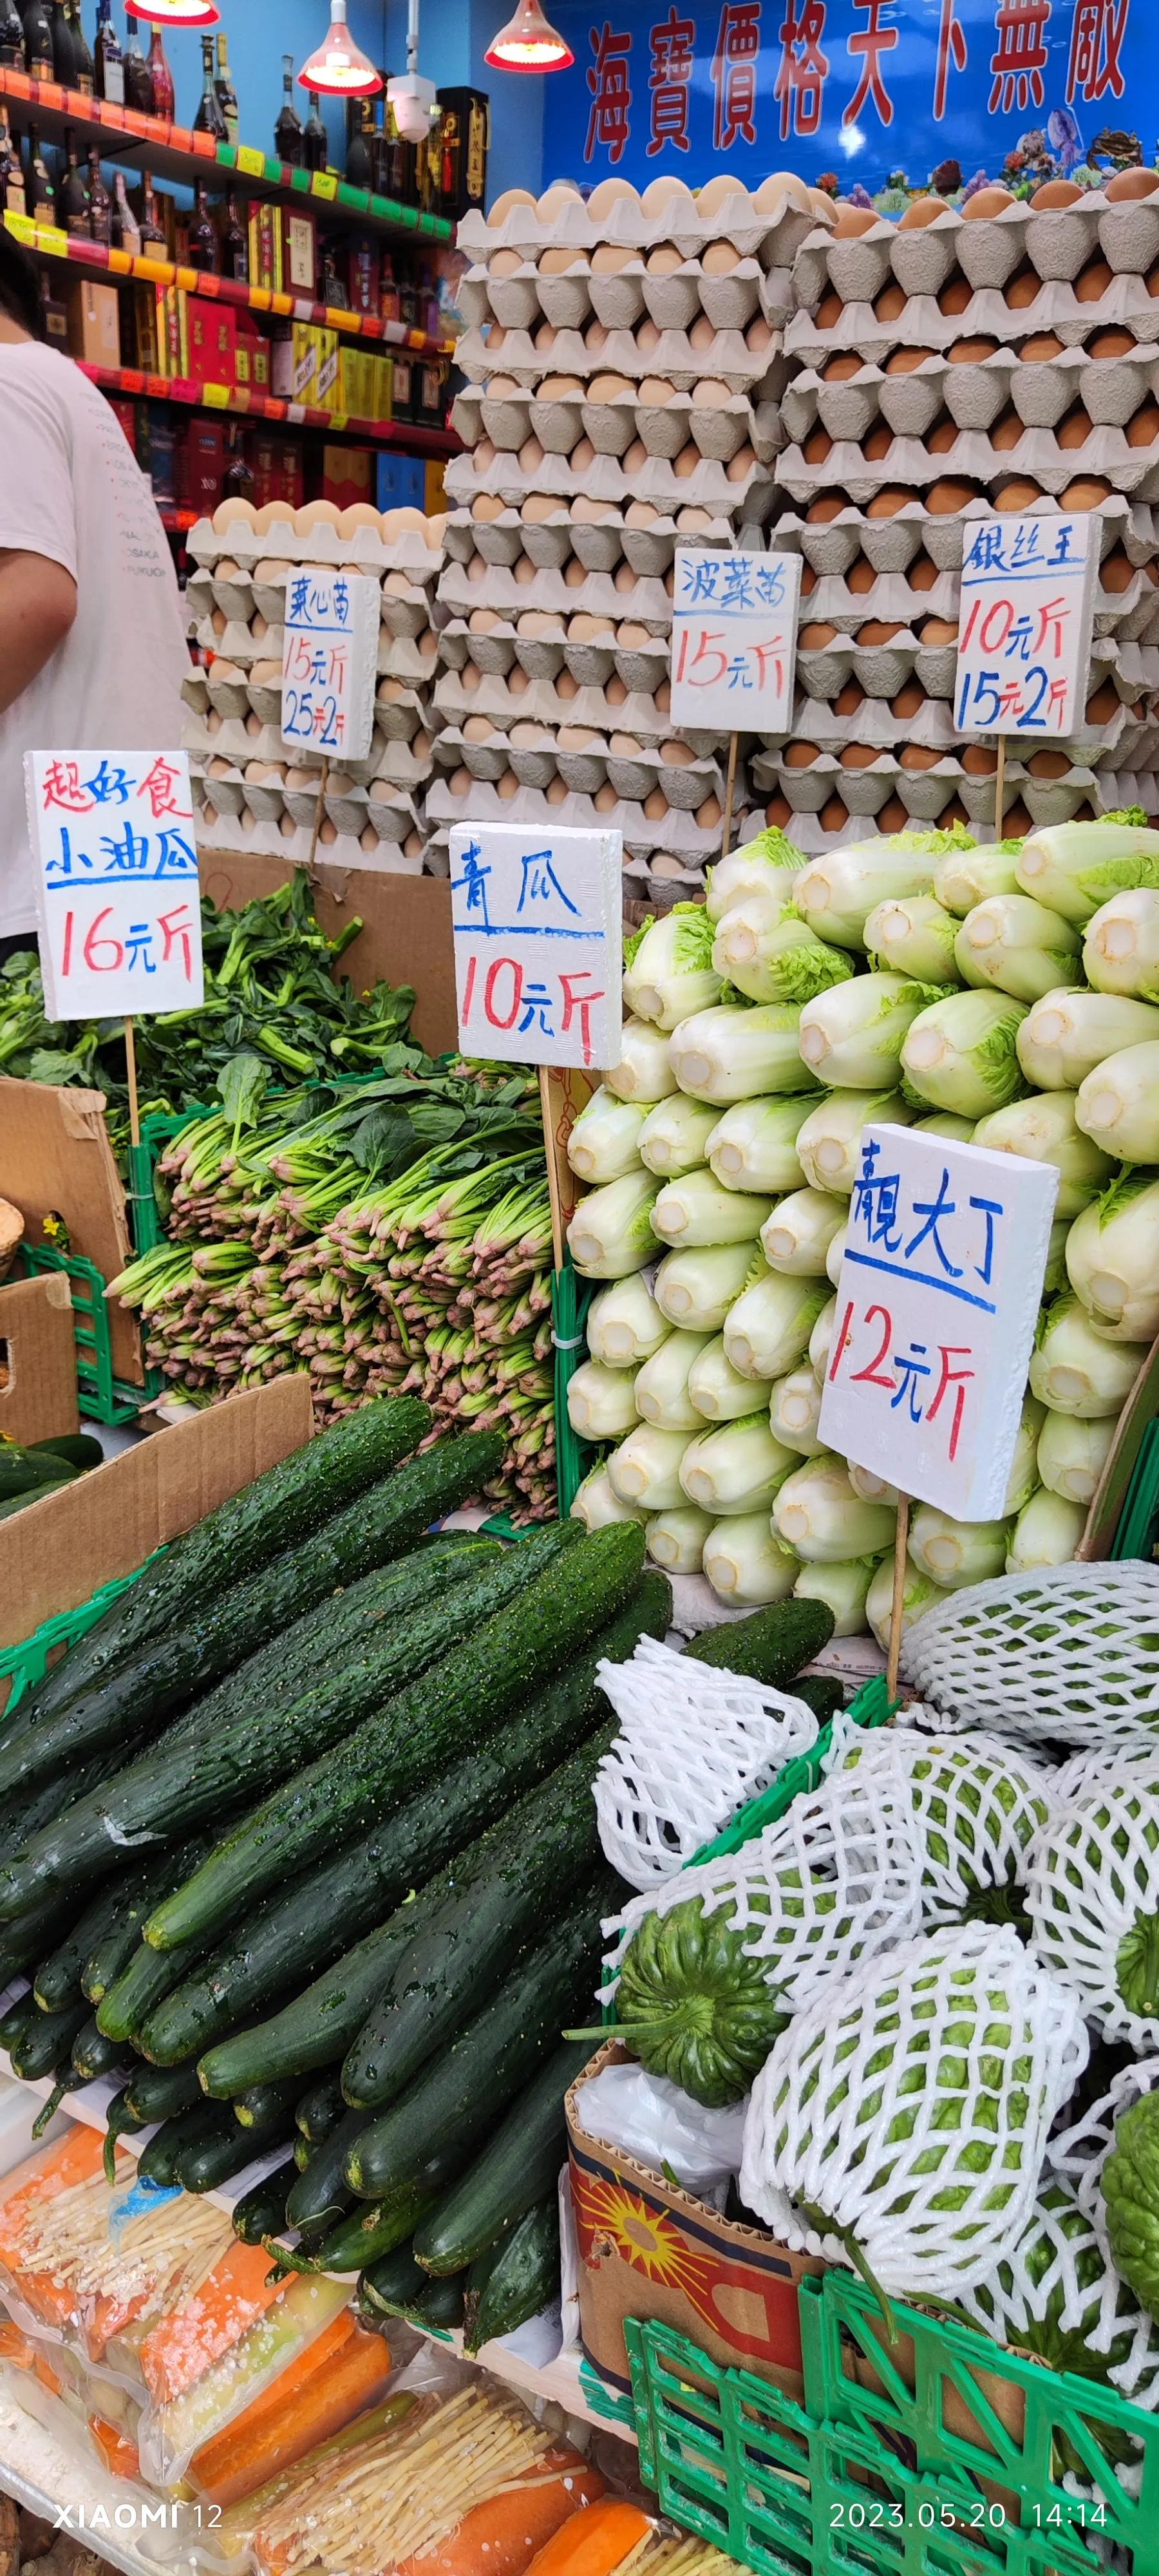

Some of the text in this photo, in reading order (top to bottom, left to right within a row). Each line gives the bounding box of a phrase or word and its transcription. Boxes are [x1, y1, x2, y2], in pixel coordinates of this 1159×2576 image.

[681, 556, 787, 611] 波菜苗
[959, 597, 1071, 661] 10元斤
[283, 636, 349, 695] 15元斤
[675, 629, 787, 700] 15元斤
[283, 690, 345, 746] 25元2斤
[957, 666, 1068, 730] 15元2斤
[42, 756, 194, 819] 超好食
[45, 821, 198, 880] 小油瓜
[450, 840, 582, 938] 青瓜
[61, 904, 193, 983] 16元斤
[462, 956, 605, 1066] 10元斤
[853, 1138, 1003, 1285] 靚大丁
[829, 1301, 975, 1463] 12元斤
